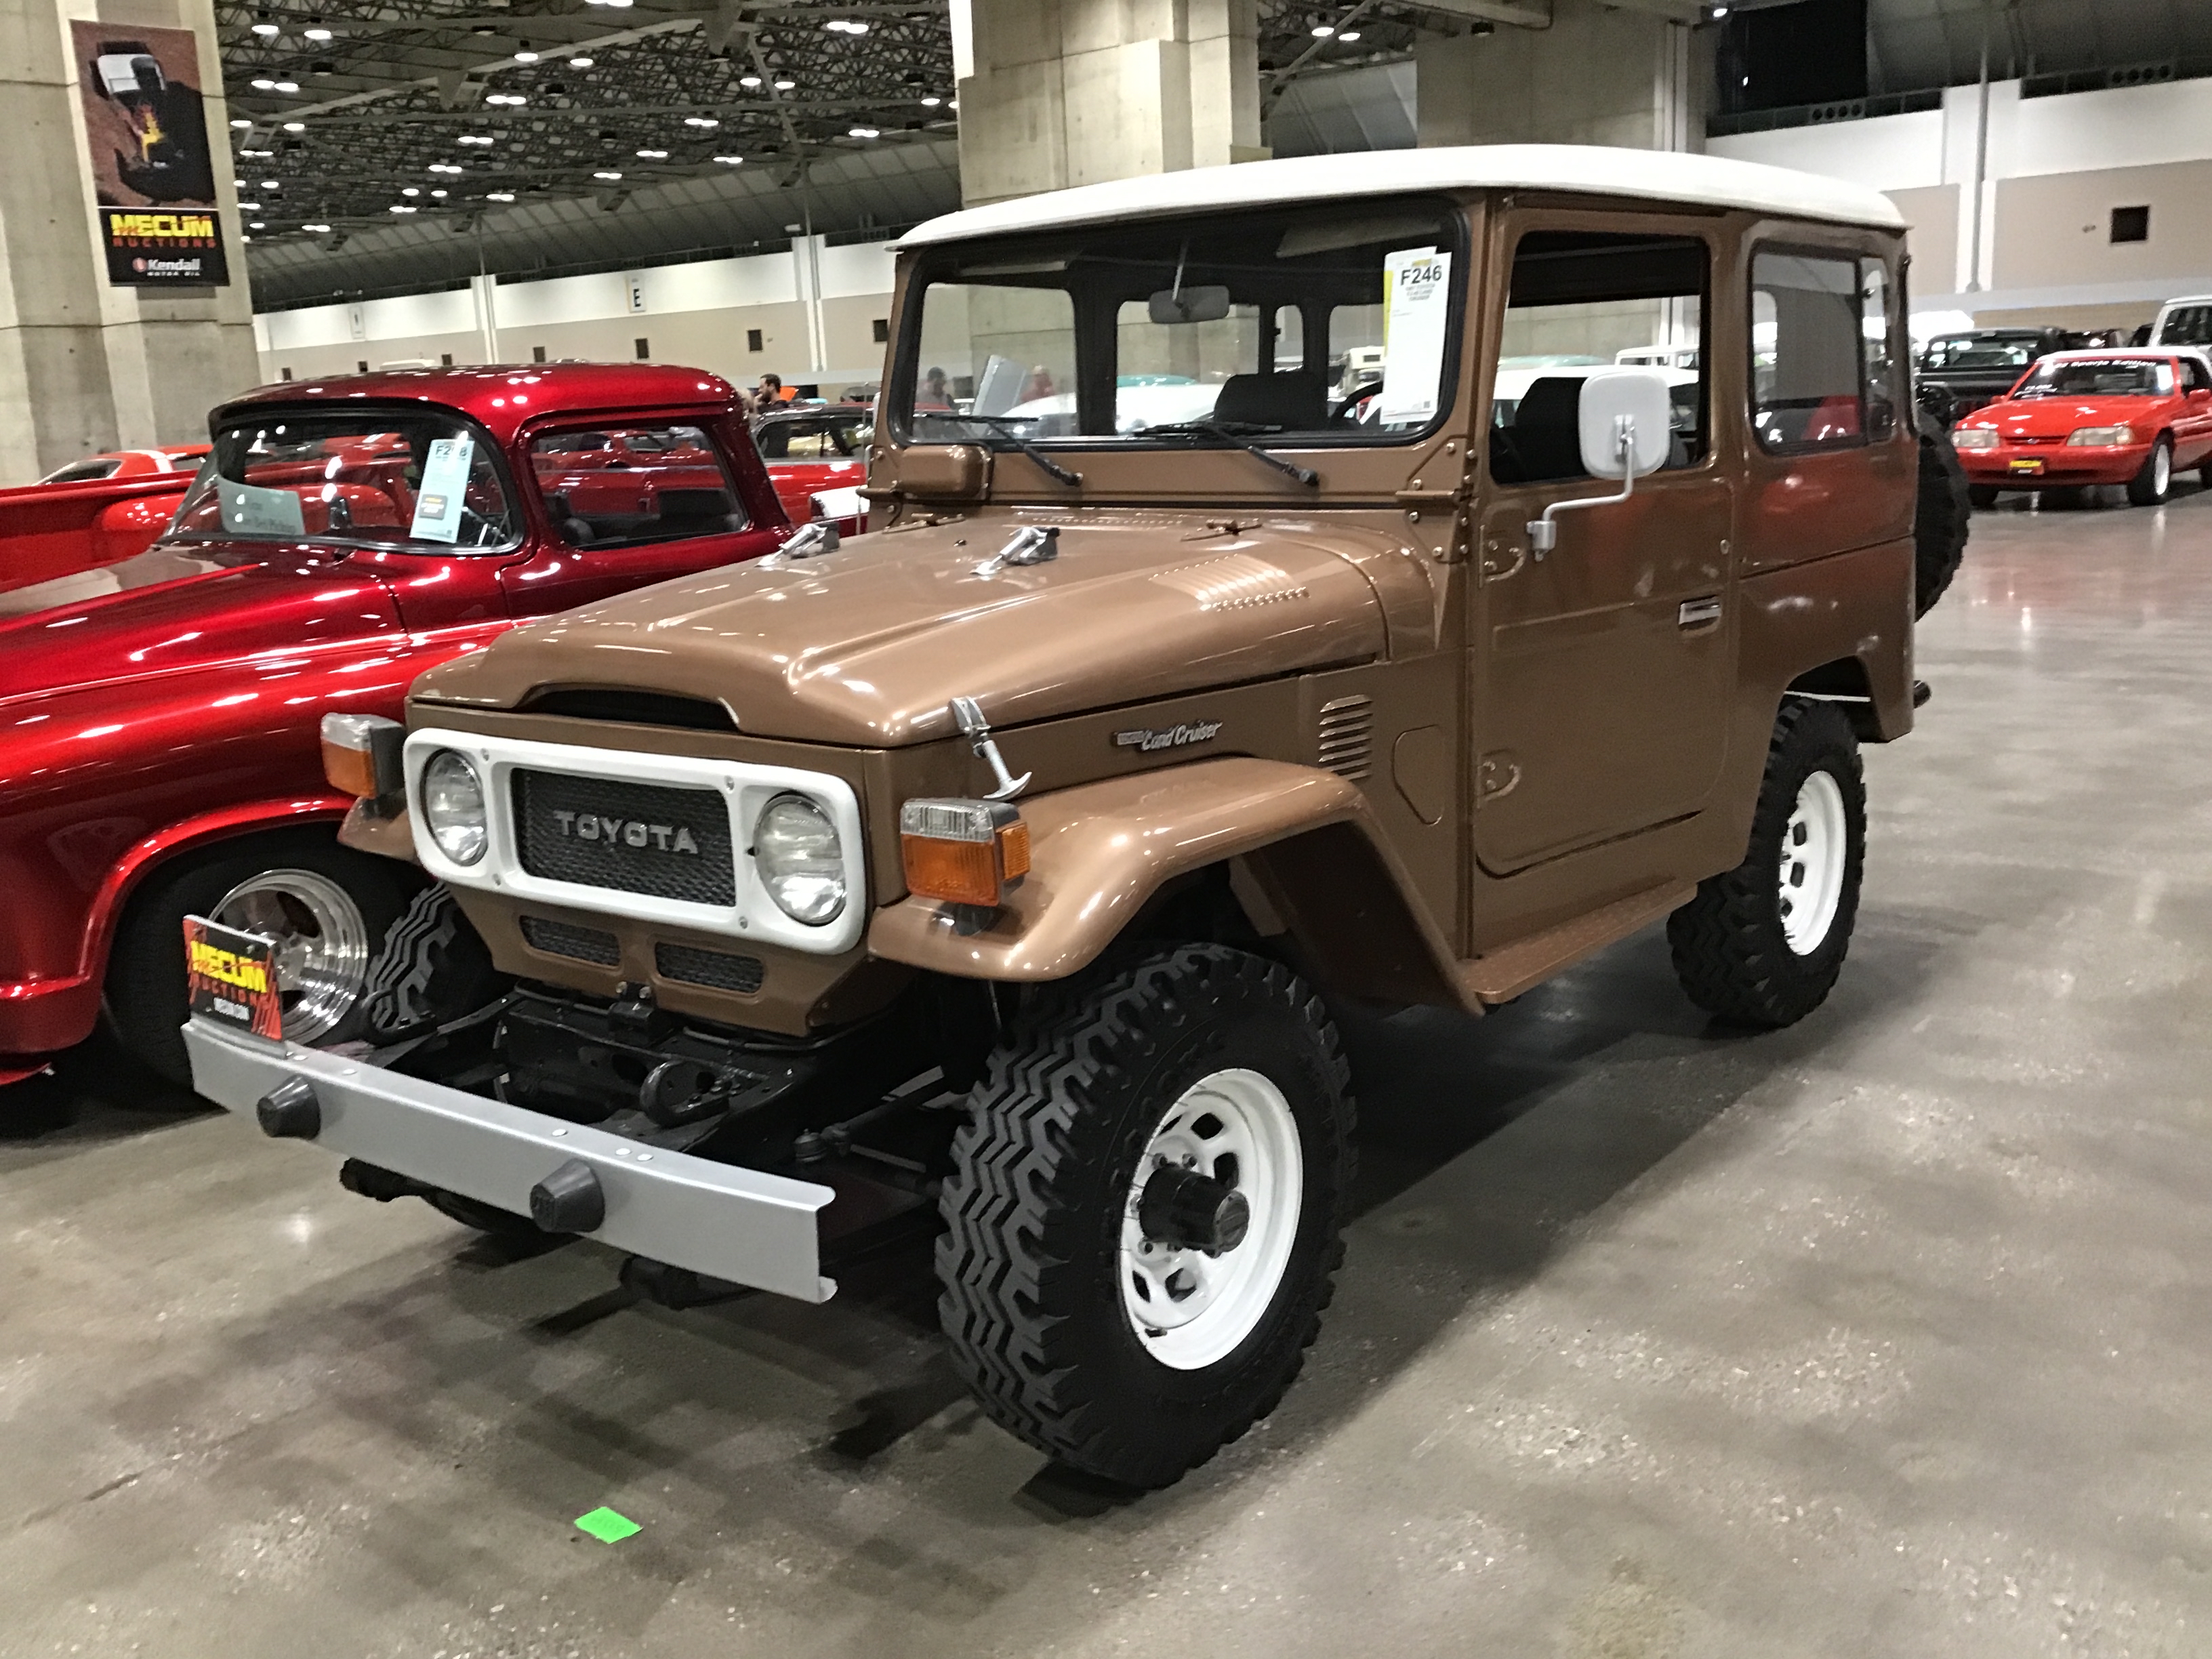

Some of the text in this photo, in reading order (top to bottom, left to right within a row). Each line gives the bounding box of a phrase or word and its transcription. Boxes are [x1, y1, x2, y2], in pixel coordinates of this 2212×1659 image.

[110, 214, 214, 237] MECUM
[112, 237, 217, 249] AUCTIONS
[147, 258, 201, 271] Kendall
[1400, 264, 1443, 286] F246
[633, 288, 641, 308] E
[1141, 724, 1179, 751] Land
[1174, 720, 1223, 745] Cruiser
[552, 809, 699, 855] TOYOTA
[190, 940, 268, 994] MECUM
